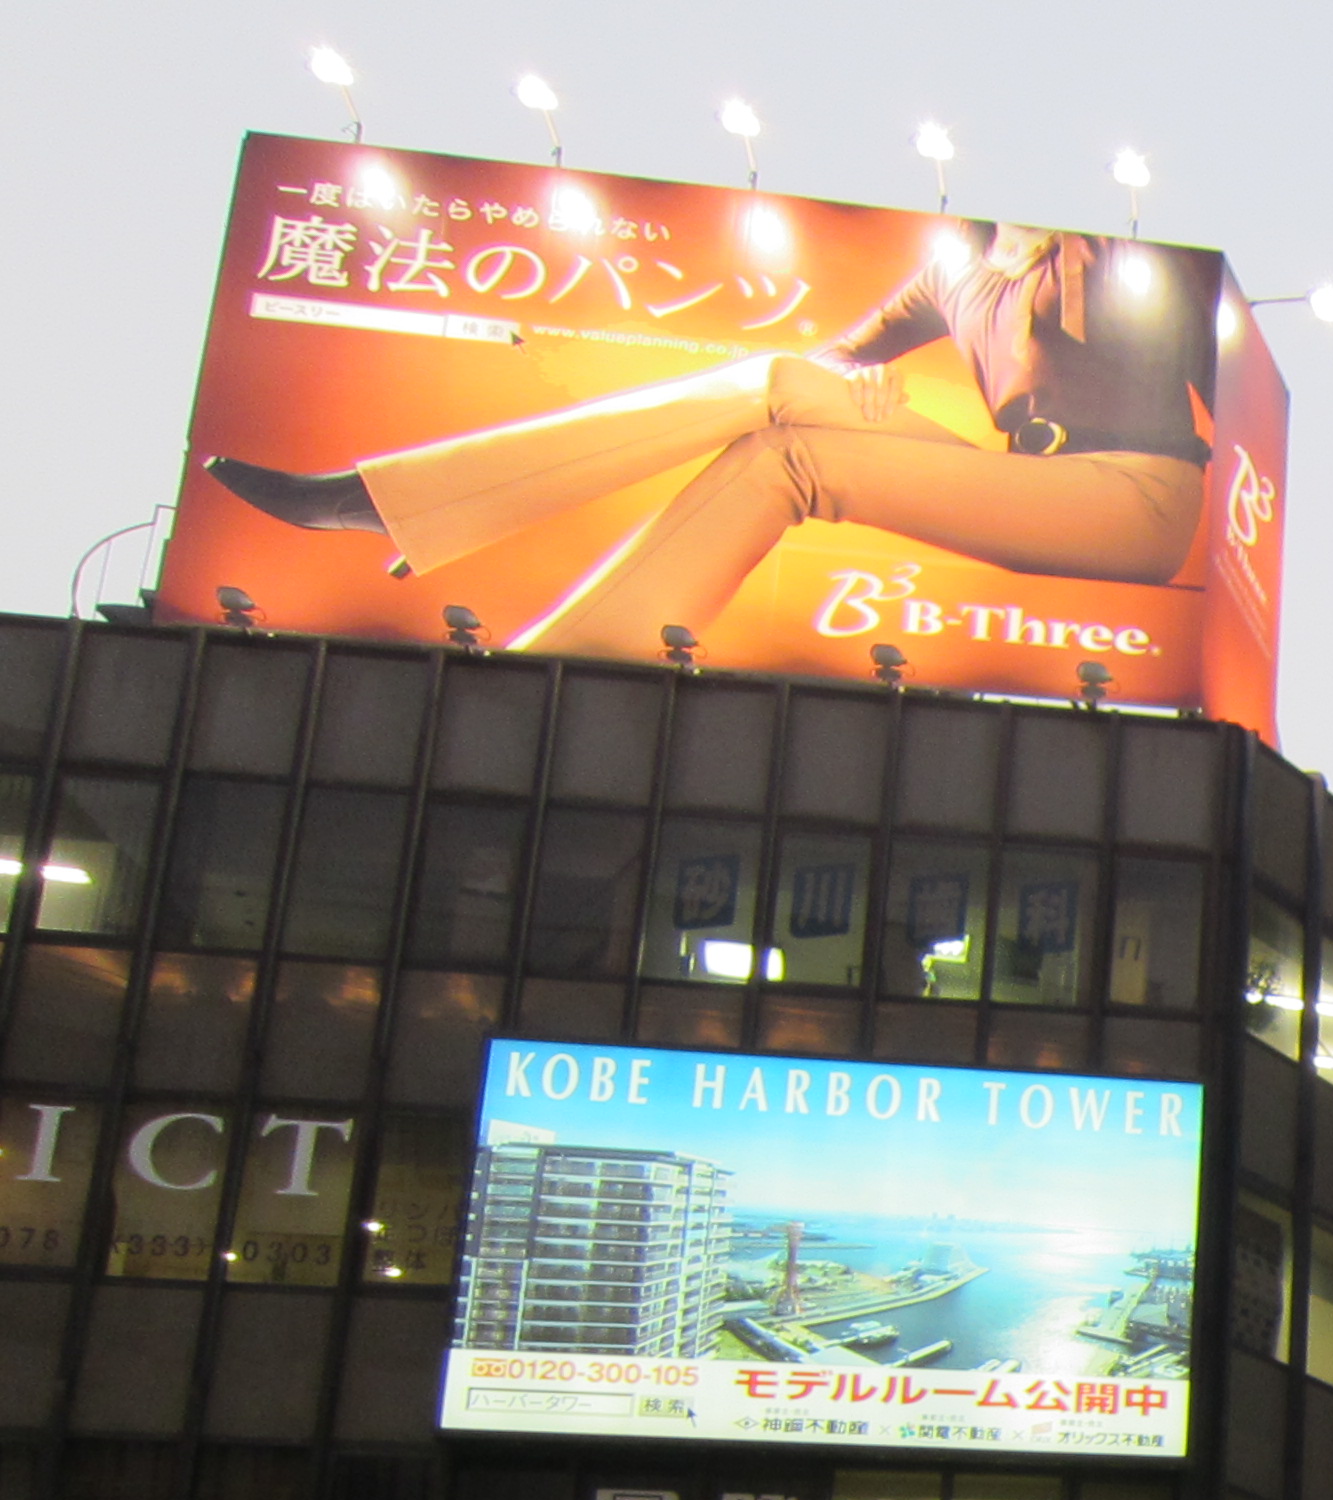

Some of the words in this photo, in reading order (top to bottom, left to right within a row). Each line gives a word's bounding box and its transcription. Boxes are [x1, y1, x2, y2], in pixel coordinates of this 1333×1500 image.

[256, 213, 812, 331] 魔法のパンツ
[532, 324, 750, 359] www.valueplanning.co.jp
[504, 1051, 653, 1105] KOBE
[691, 1062, 943, 1123] HARBOR
[982, 1080, 1185, 1138] TOWER
[507, 1359, 700, 1387] 0120-300-105
[734, 1368, 1170, 1418] モデルルーム公開中
[643, 1395, 686, 1415] 検索
